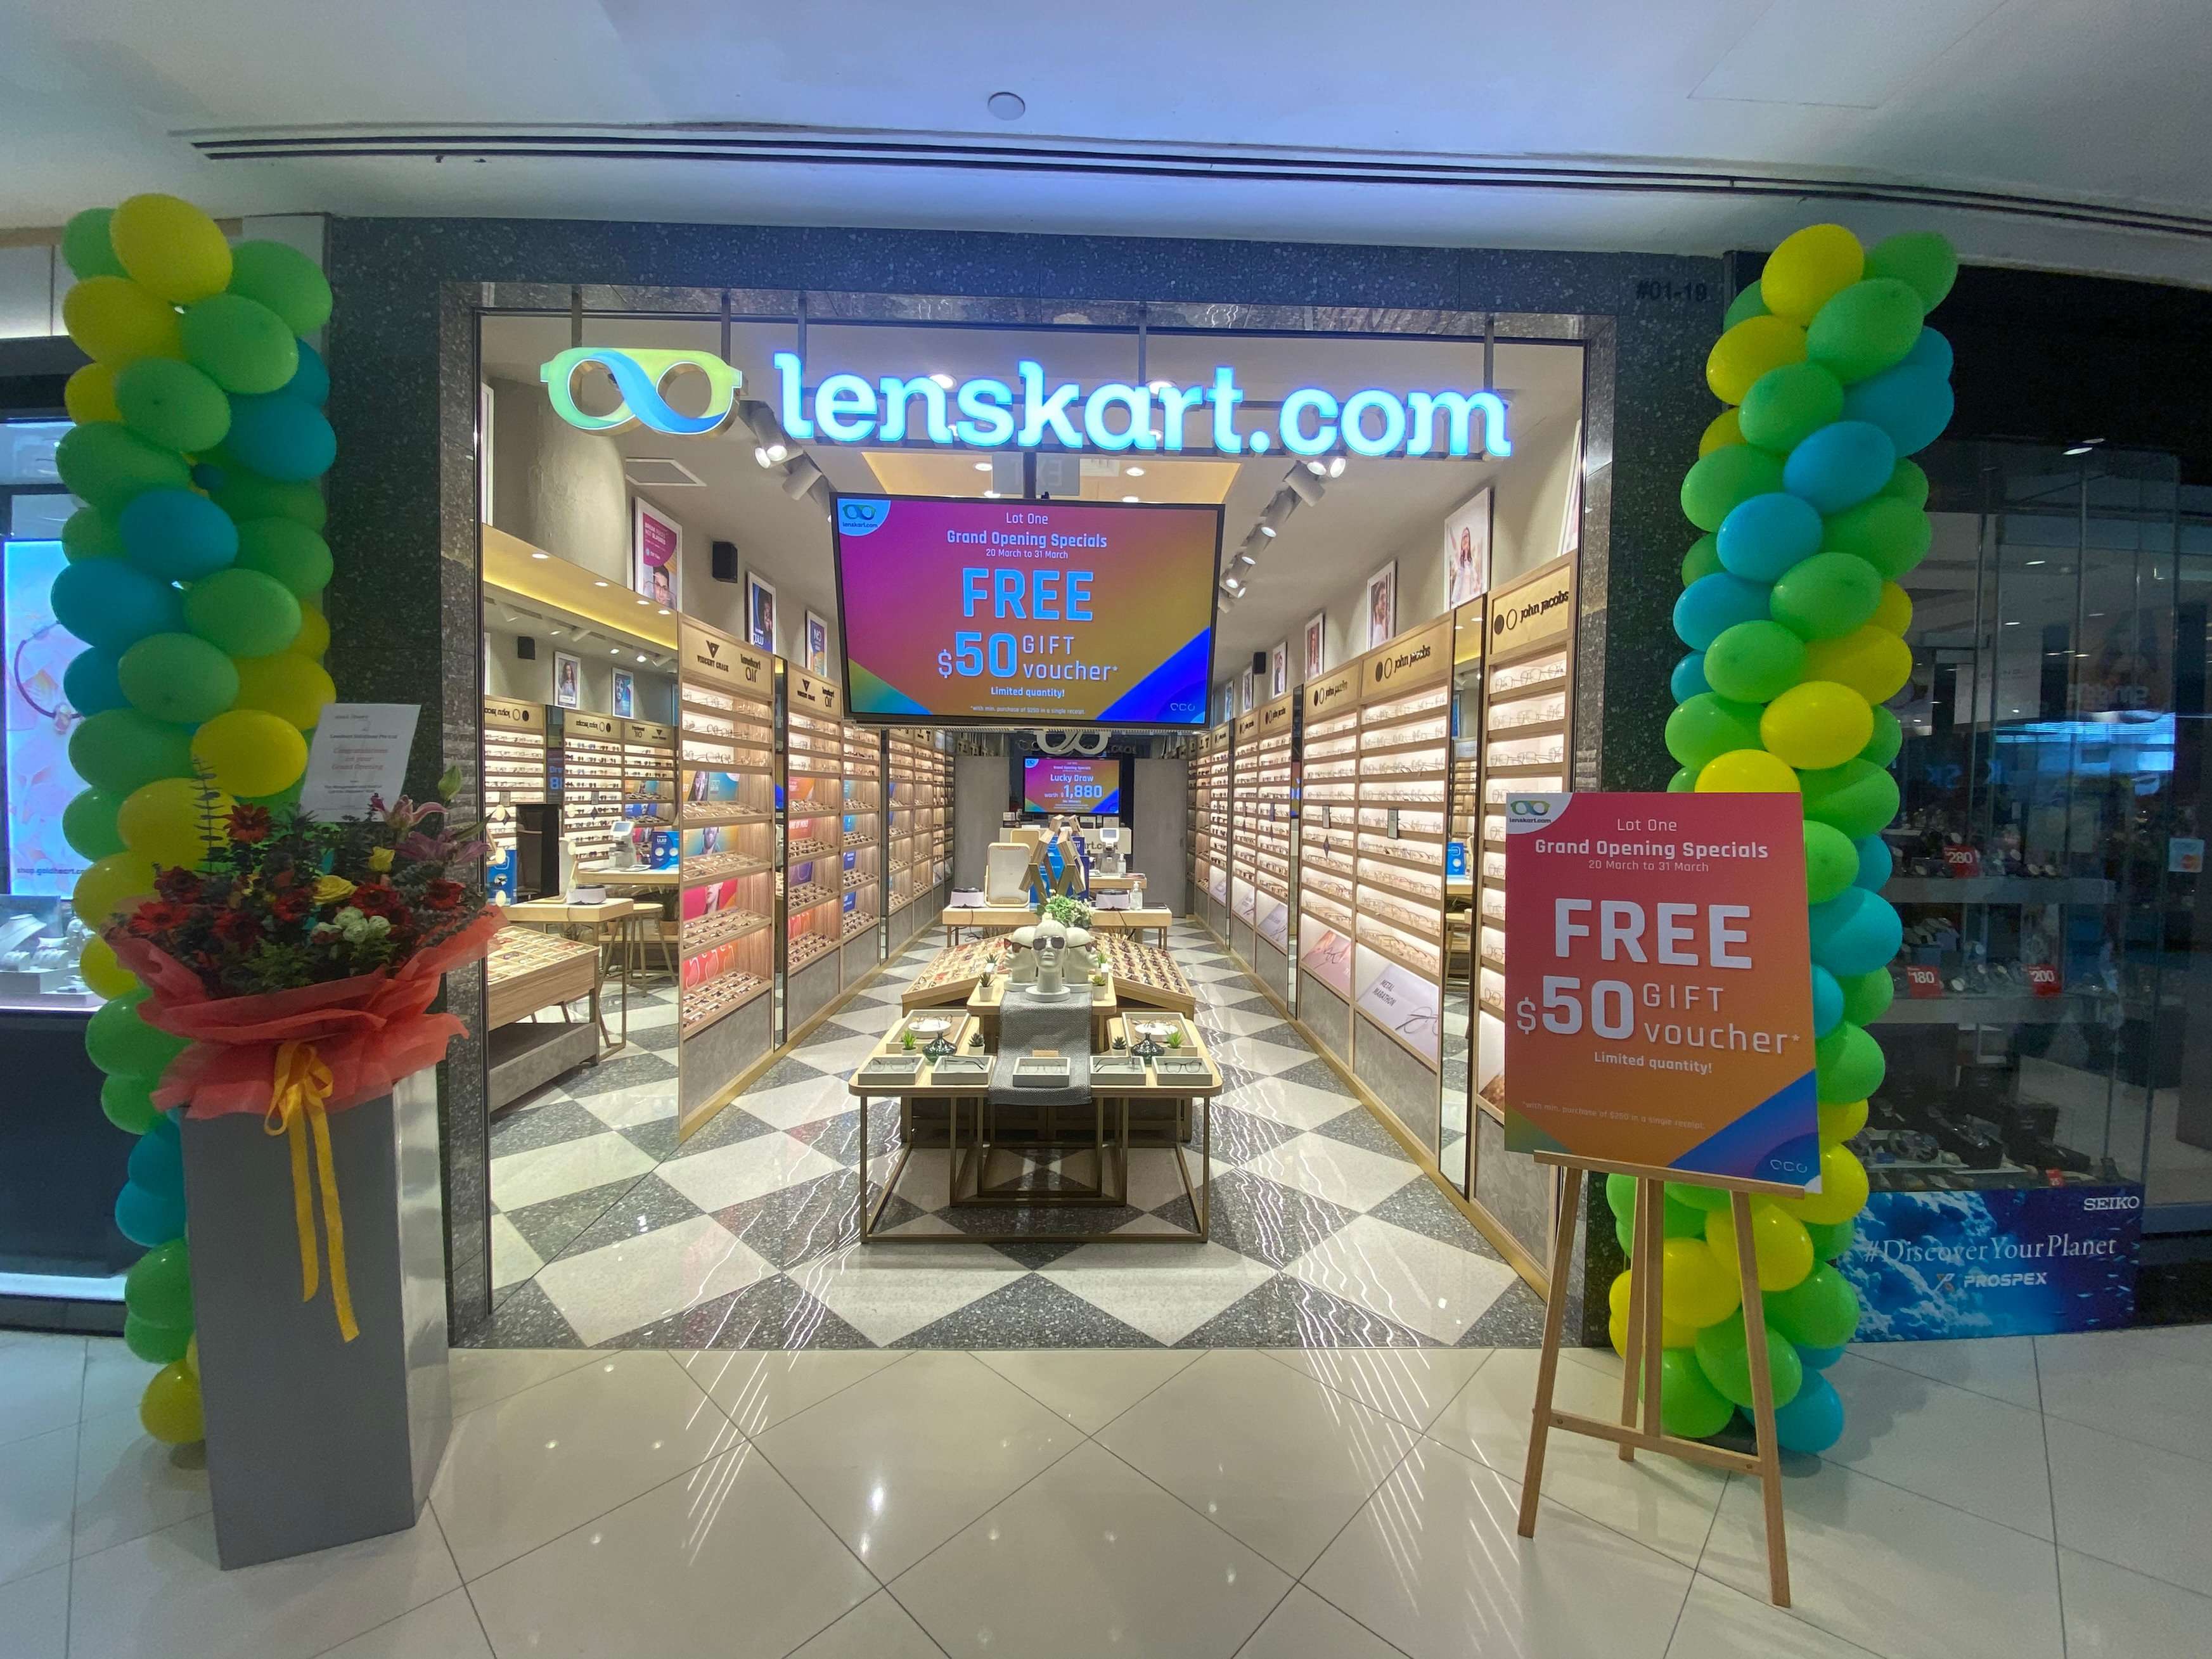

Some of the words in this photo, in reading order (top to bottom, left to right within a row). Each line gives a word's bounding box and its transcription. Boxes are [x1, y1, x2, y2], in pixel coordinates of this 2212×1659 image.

[774, 353, 1512, 456] lenskart.com
[1006, 513, 1023, 523] Lot
[1027, 513, 1048, 525] One
[947, 530, 987, 544] Grand
[991, 531, 1046, 549] Opening
[1051, 534, 1107, 548] Specials
[986, 549, 995, 557] 20
[998, 549, 1021, 558] March
[1045, 551, 1068, 559] March
[963, 568, 1093, 621] FREE
[1521, 604, 1539, 623] john
[1541, 591, 1569, 615] jacobs
[938, 631, 1017, 679] $50
[1023, 635, 1074, 654] GIFT
[1394, 655, 1408, 673] john
[1410, 645, 1431, 667] jacobs
[991, 687, 1023, 696] Limited
[1026, 688, 1065, 698] quantity!
[1050, 774, 1072, 782] Lucky
[1617, 819, 1642, 831] Lot
[1648, 819, 1677, 831] One
[1536, 839, 1589, 854] Grand
[1597, 840, 1675, 859] Opening
[1683, 842, 1768, 859] Specials
[1589, 860, 1602, 869] 20
[1606, 861, 1638, 870] March
[1643, 862, 1654, 871] to
[1659, 862, 1669, 871] 31
[1675, 862, 1709, 872] March
[1555, 898, 1752, 969] FREE
[1517, 976, 1634, 1039] $50
[1643, 983, 1724, 1011] GIFT
[1595, 1051, 1644, 1066] Limited
[1649, 1058, 1712, 1075] quantity!
[1562, 1106, 1597, 1117] purchase
[1649, 1117, 1672, 1126] single
[2083, 1196, 2140, 1210] SEIKO
[1965, 1272, 2048, 1287] PROSPEX
